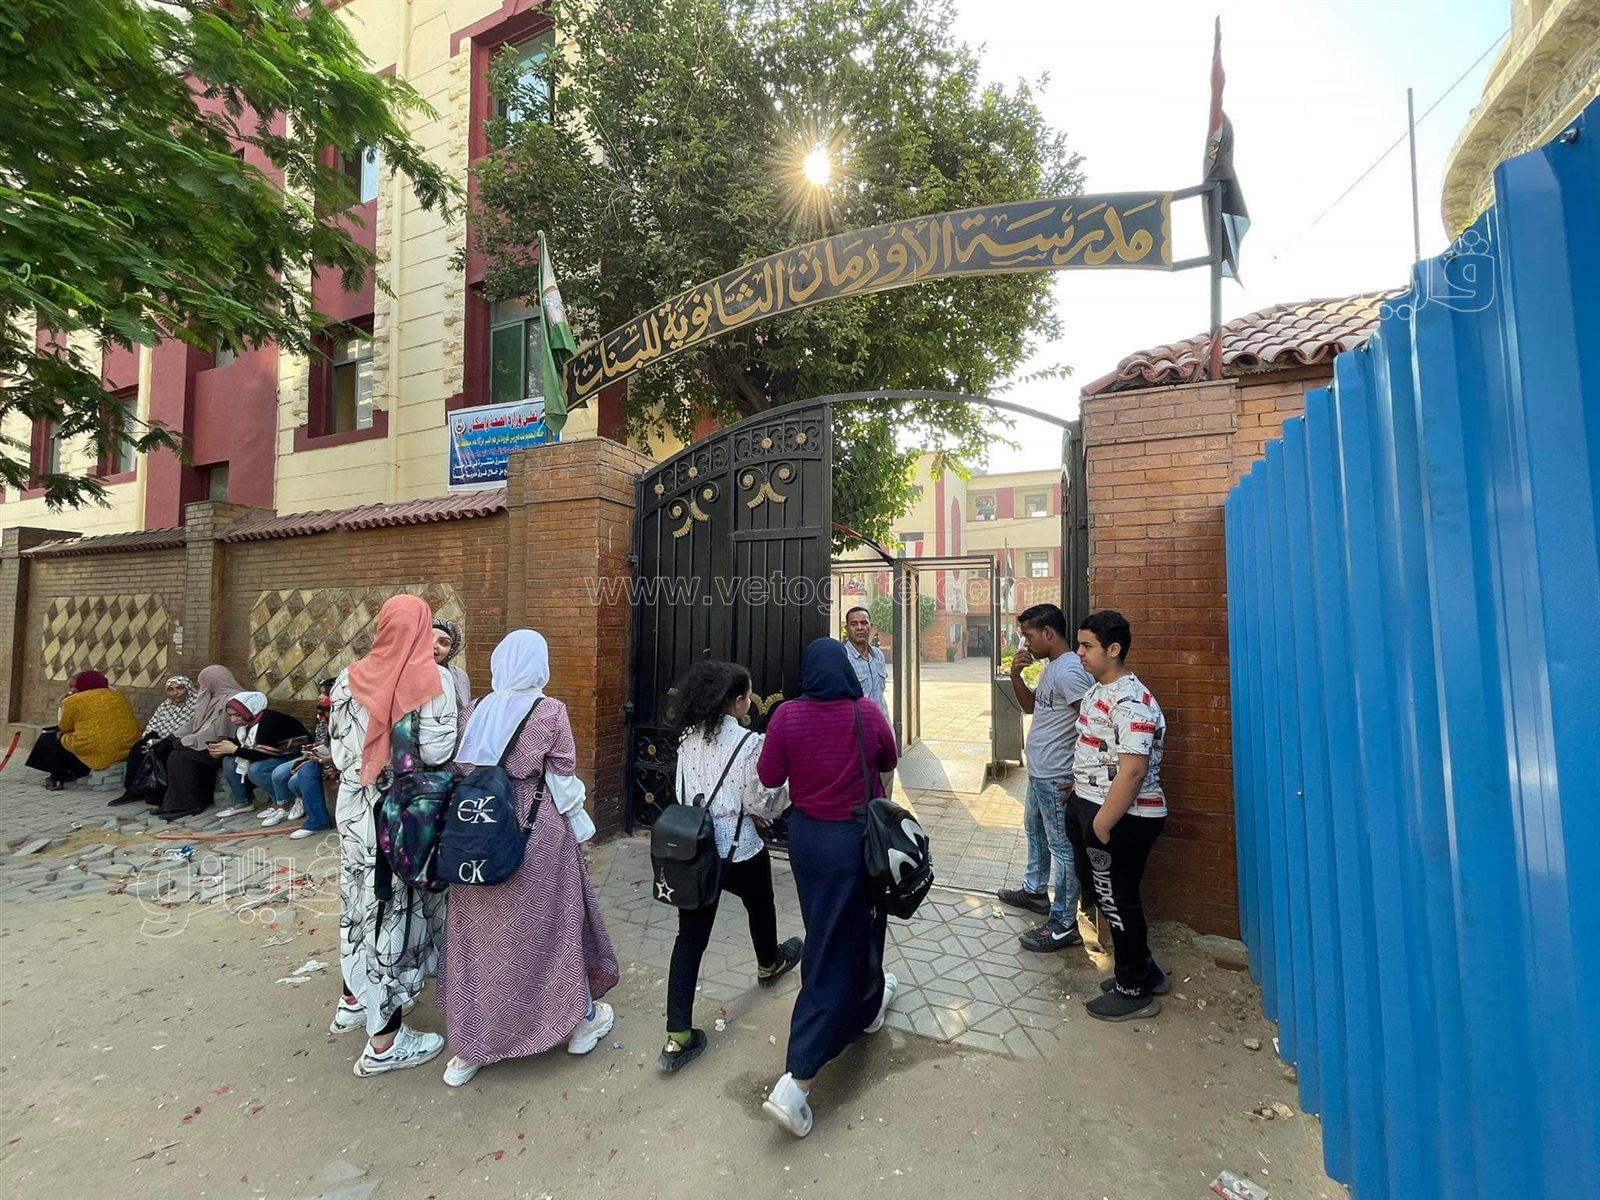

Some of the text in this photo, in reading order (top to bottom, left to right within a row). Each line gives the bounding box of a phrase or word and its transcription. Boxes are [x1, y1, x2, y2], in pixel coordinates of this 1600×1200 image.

[955, 199, 1158, 266] مدرسة
[574, 318, 662, 395] للبنات
[458, 859, 488, 883] CK
[1092, 869, 1126, 931] VERSACE
